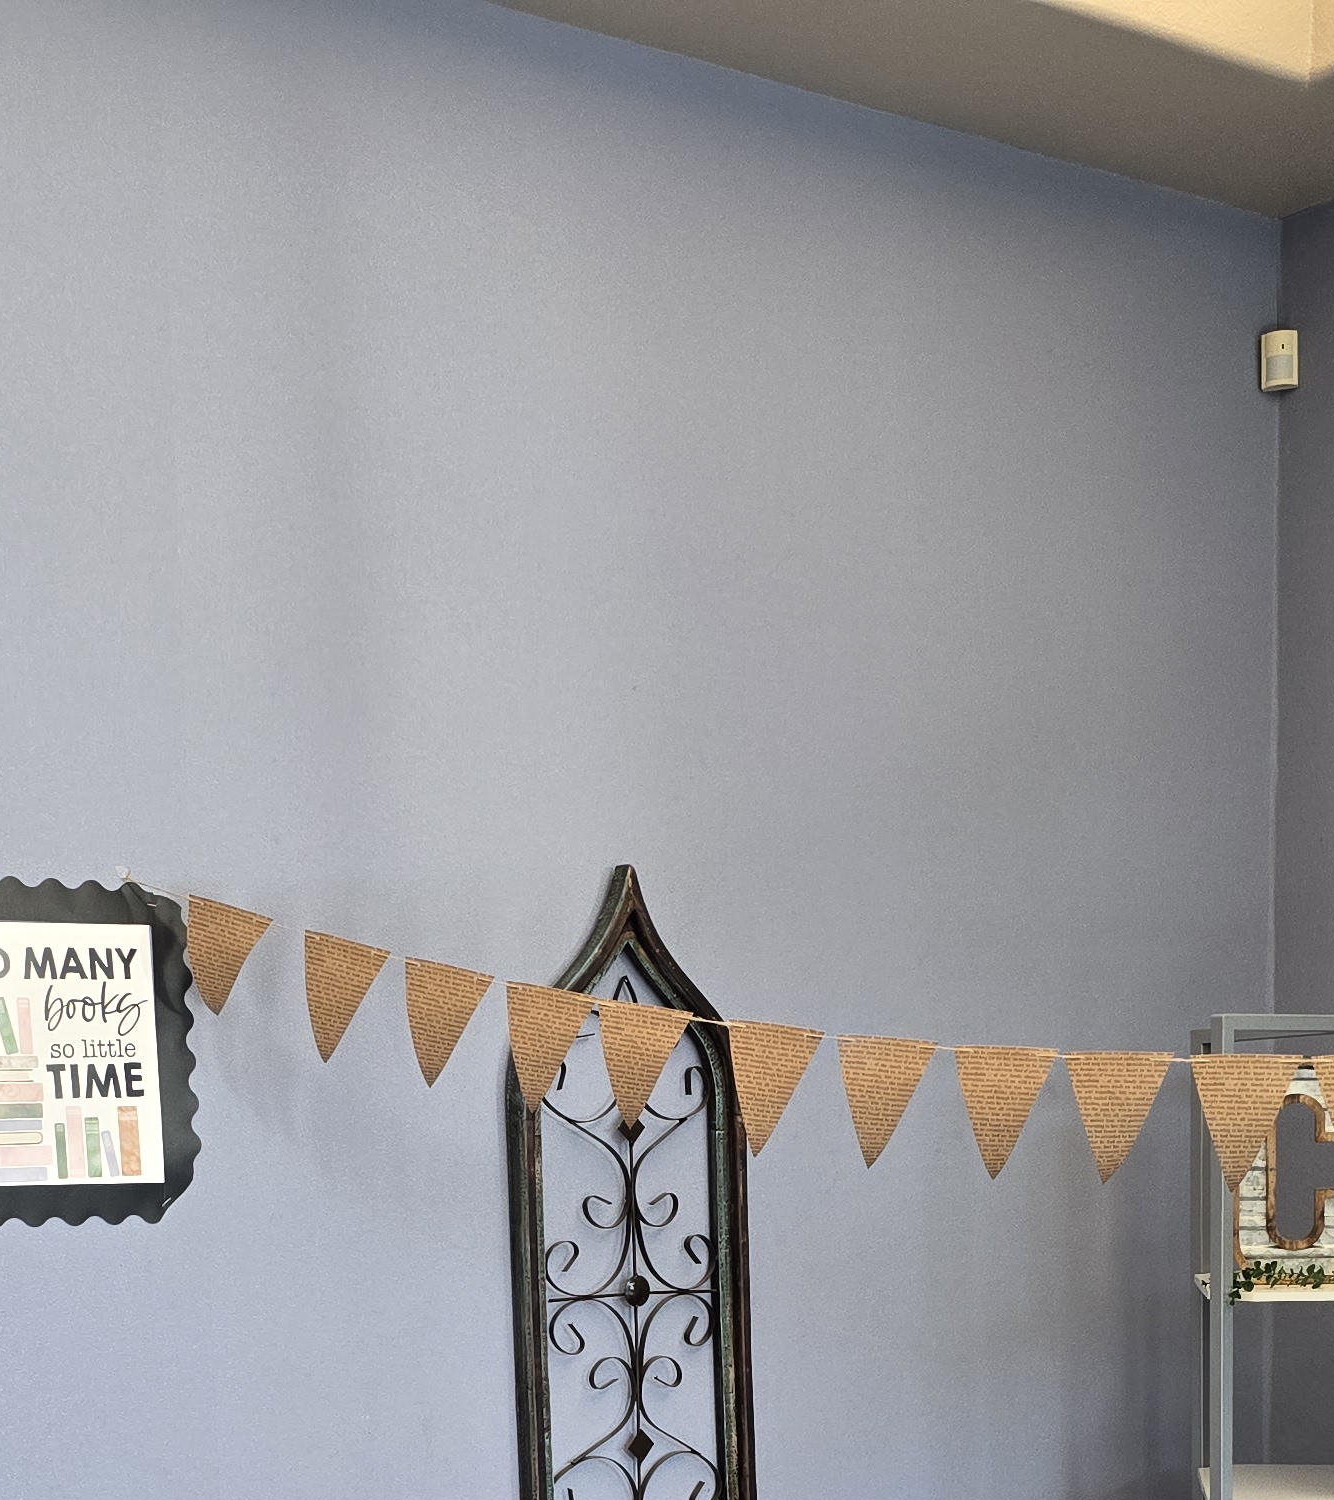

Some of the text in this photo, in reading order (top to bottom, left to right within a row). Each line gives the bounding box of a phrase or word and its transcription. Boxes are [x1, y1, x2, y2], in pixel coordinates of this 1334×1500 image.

[24, 947, 137, 980] MANY
[44, 981, 148, 1036] books
[50, 1038, 137, 1059] so little
[46, 1062, 145, 1099] TIME
